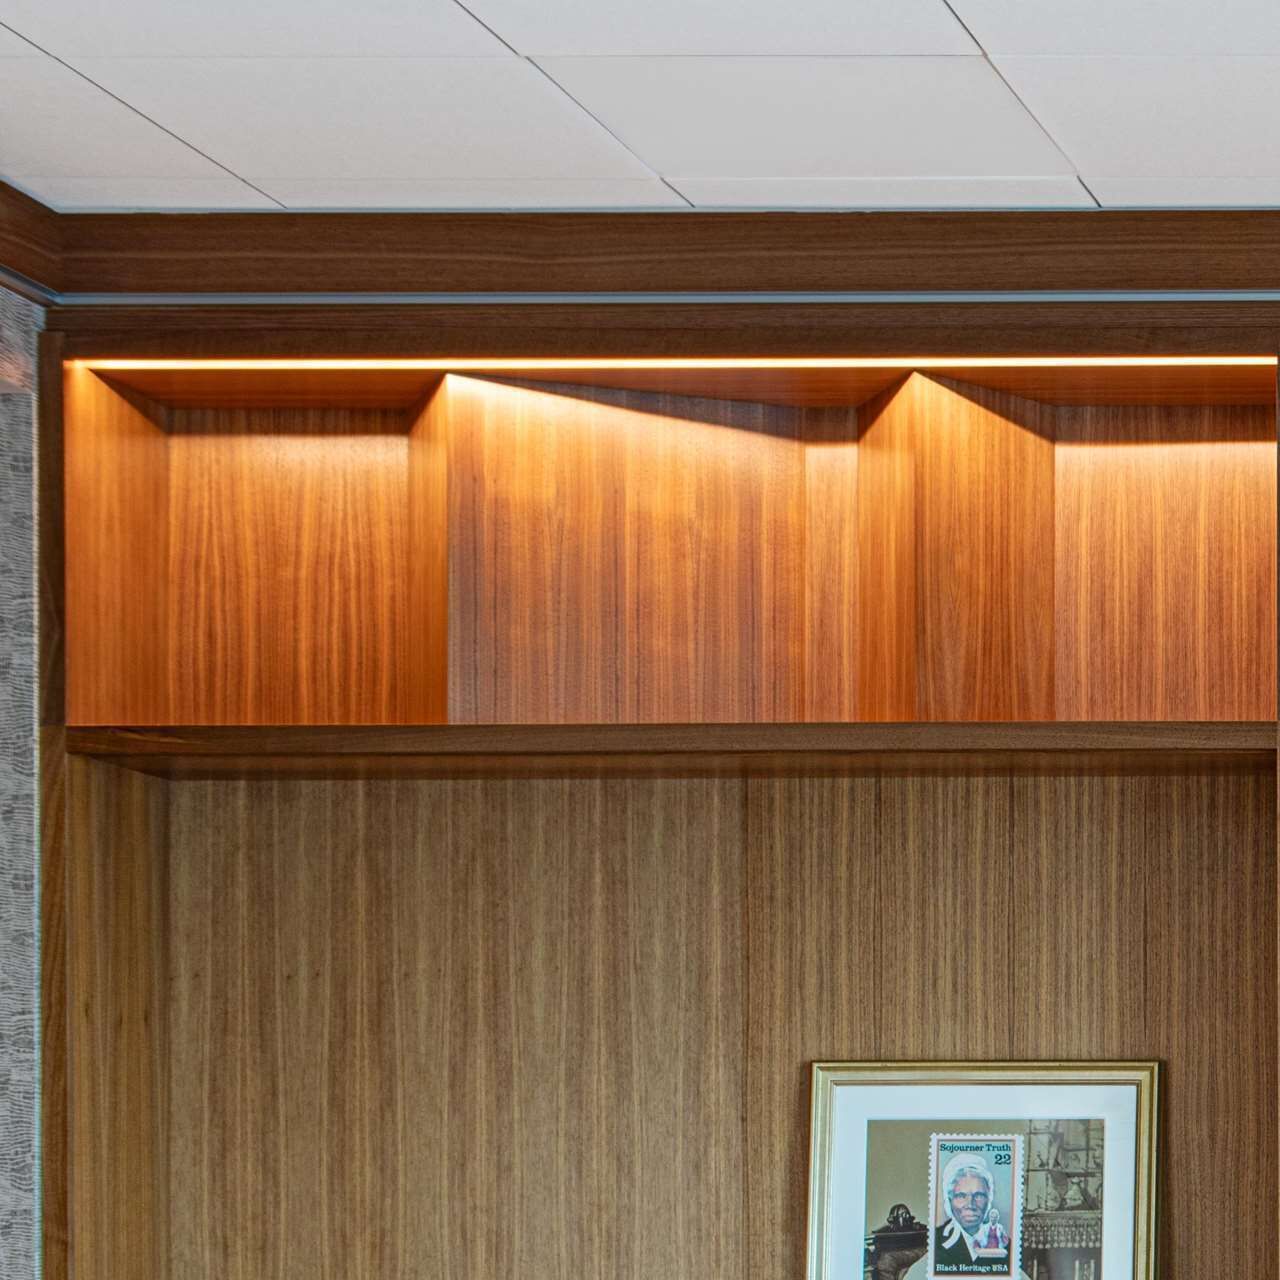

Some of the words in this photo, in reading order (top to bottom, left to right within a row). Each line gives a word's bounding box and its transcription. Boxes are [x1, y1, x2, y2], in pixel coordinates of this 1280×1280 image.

[939, 1144, 985, 1153] Sojourner
[986, 1144, 1012, 1152] Truth
[994, 1154, 1012, 1165] 22
[936, 1263, 958, 1272] Black
[959, 1263, 991, 1273] Heritage
[992, 1263, 1009, 1272] USA
